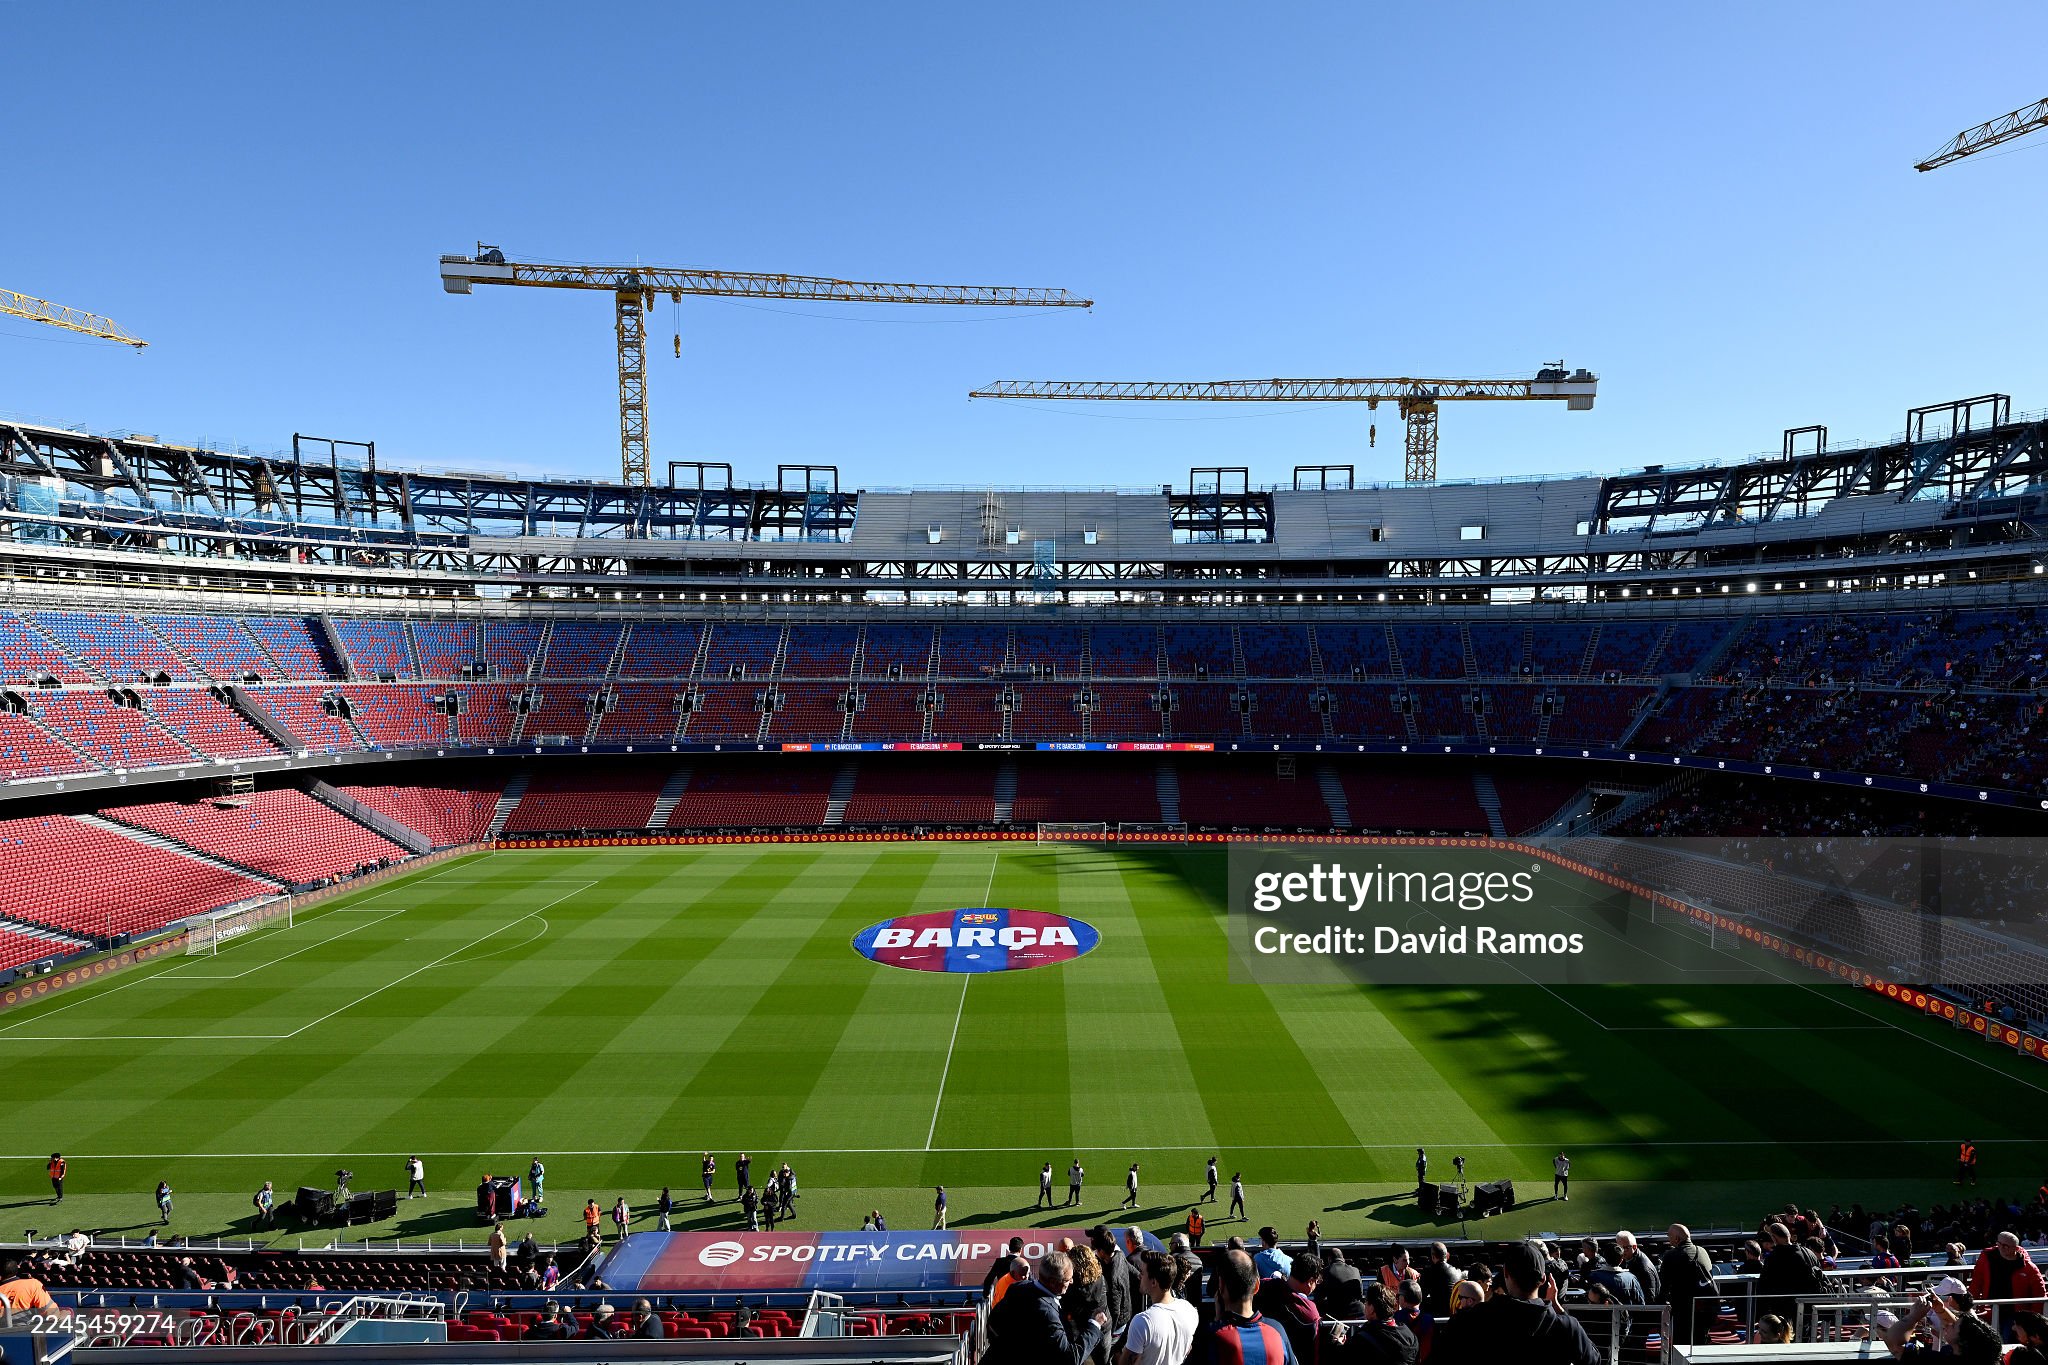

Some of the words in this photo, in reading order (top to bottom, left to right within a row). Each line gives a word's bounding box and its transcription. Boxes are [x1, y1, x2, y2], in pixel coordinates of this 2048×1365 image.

[872, 926, 1078, 950] BARÇA
[748, 1244, 889, 1262] SPOTIFY
[896, 1243, 992, 1261] CAMP
[1000, 1242, 1054, 1259] NO
